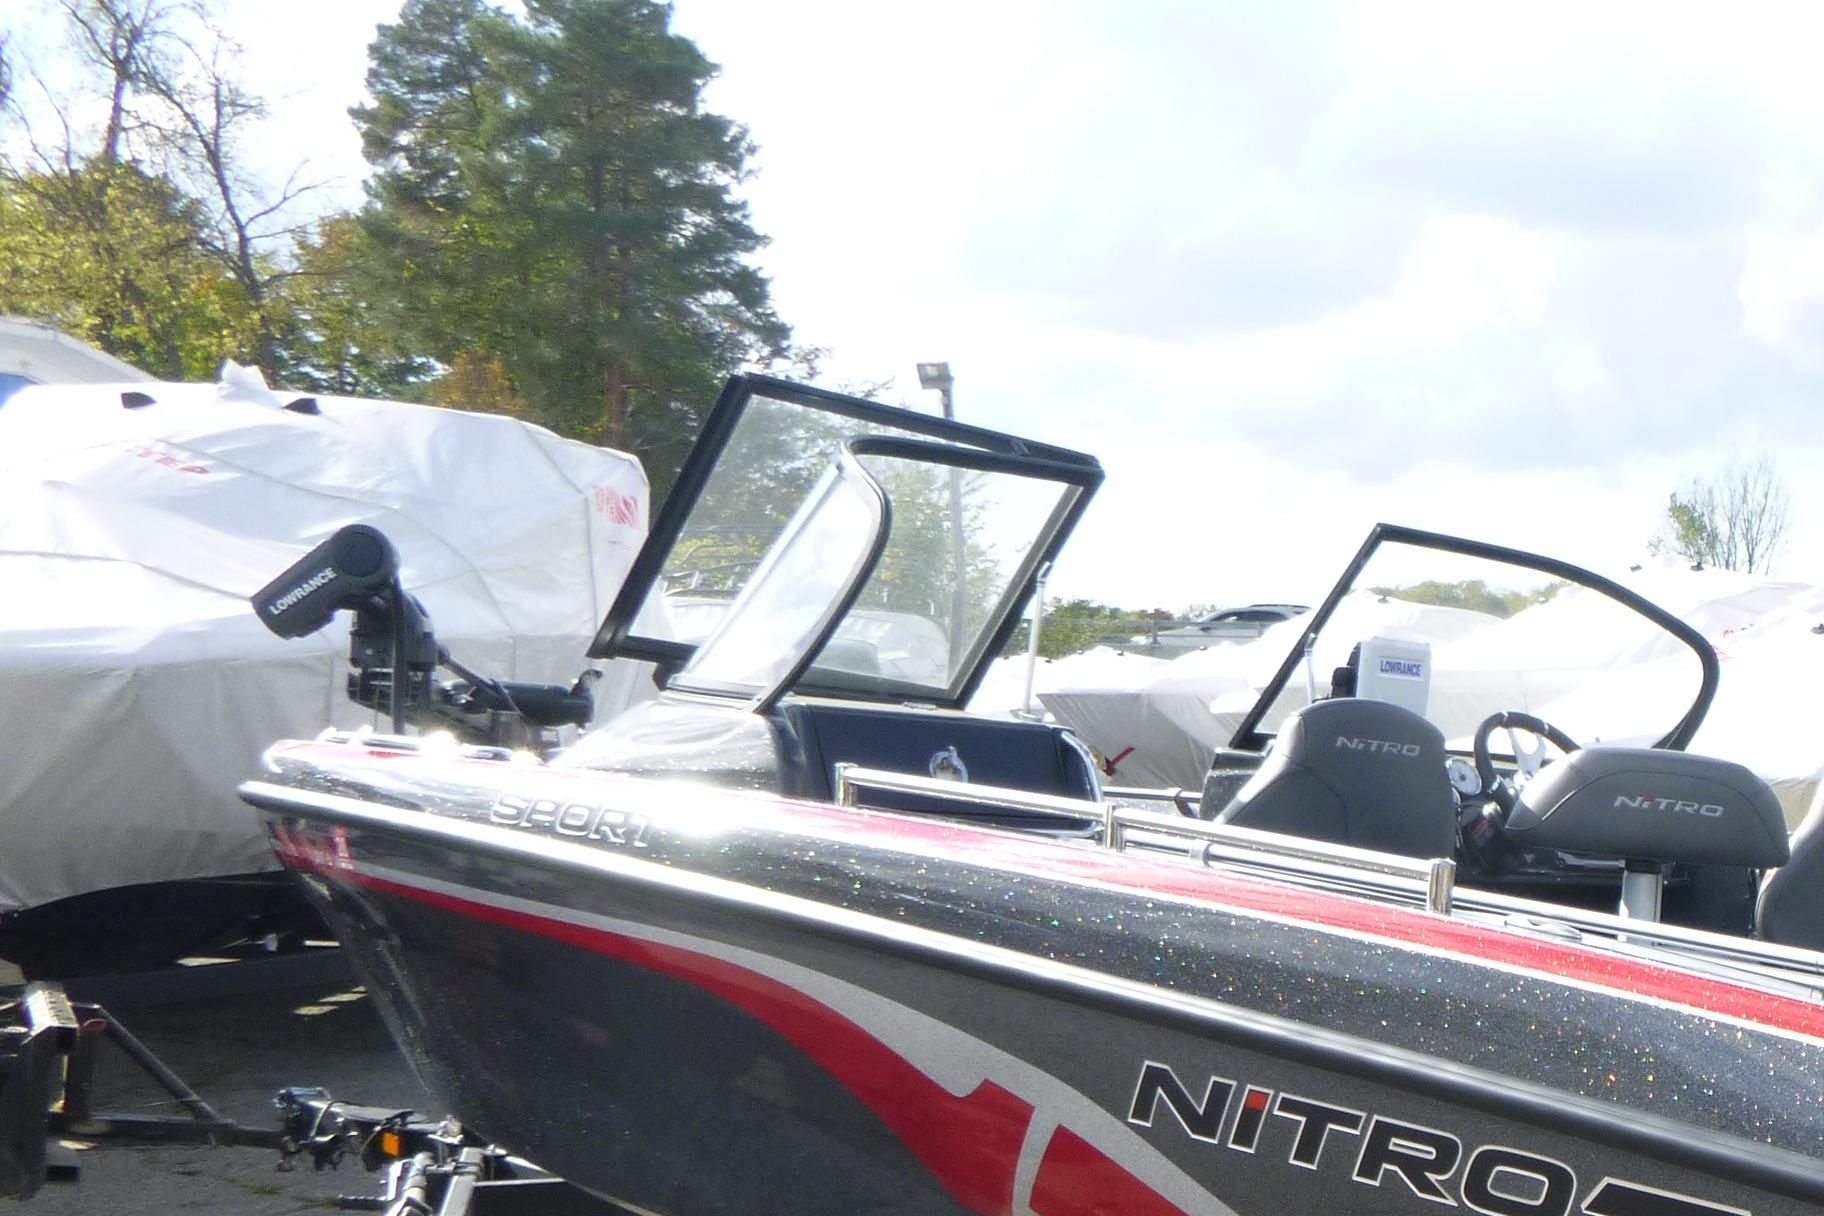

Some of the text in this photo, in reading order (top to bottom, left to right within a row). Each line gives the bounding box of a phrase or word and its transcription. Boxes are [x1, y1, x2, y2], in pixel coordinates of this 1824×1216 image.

[268, 566, 338, 616] LOWRANCE
[1379, 660, 1423, 677] LOWRANCE
[491, 798, 652, 848] SPORT
